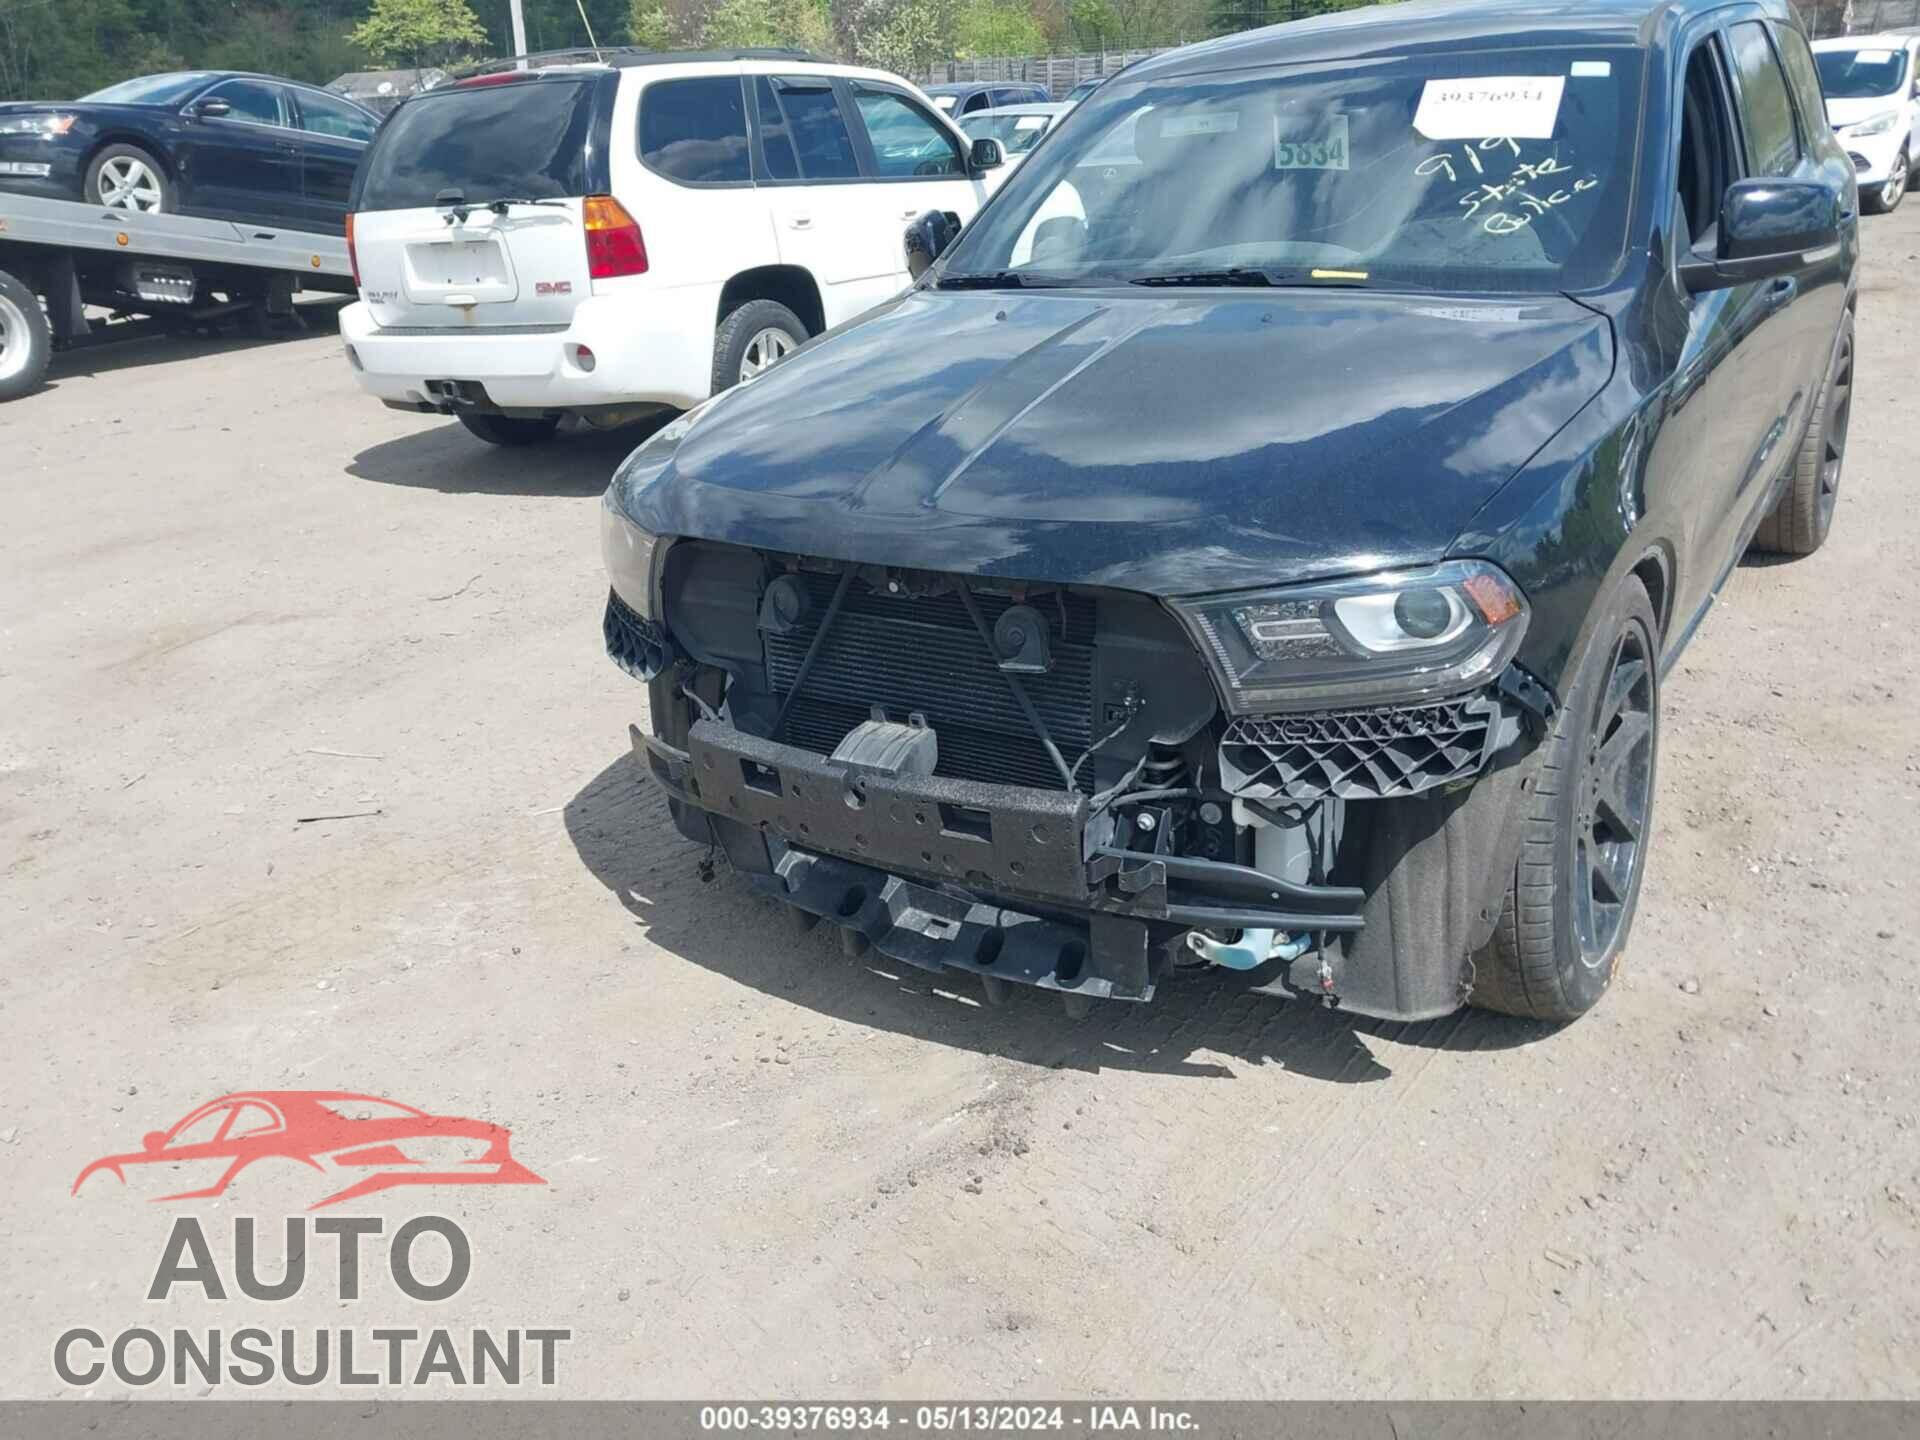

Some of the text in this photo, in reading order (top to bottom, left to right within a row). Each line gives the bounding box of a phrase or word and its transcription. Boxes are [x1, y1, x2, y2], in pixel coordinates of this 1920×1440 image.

[1435, 90, 1543, 105] 39376934
[1279, 137, 1344, 167] 5834
[535, 282, 572, 295] GMC
